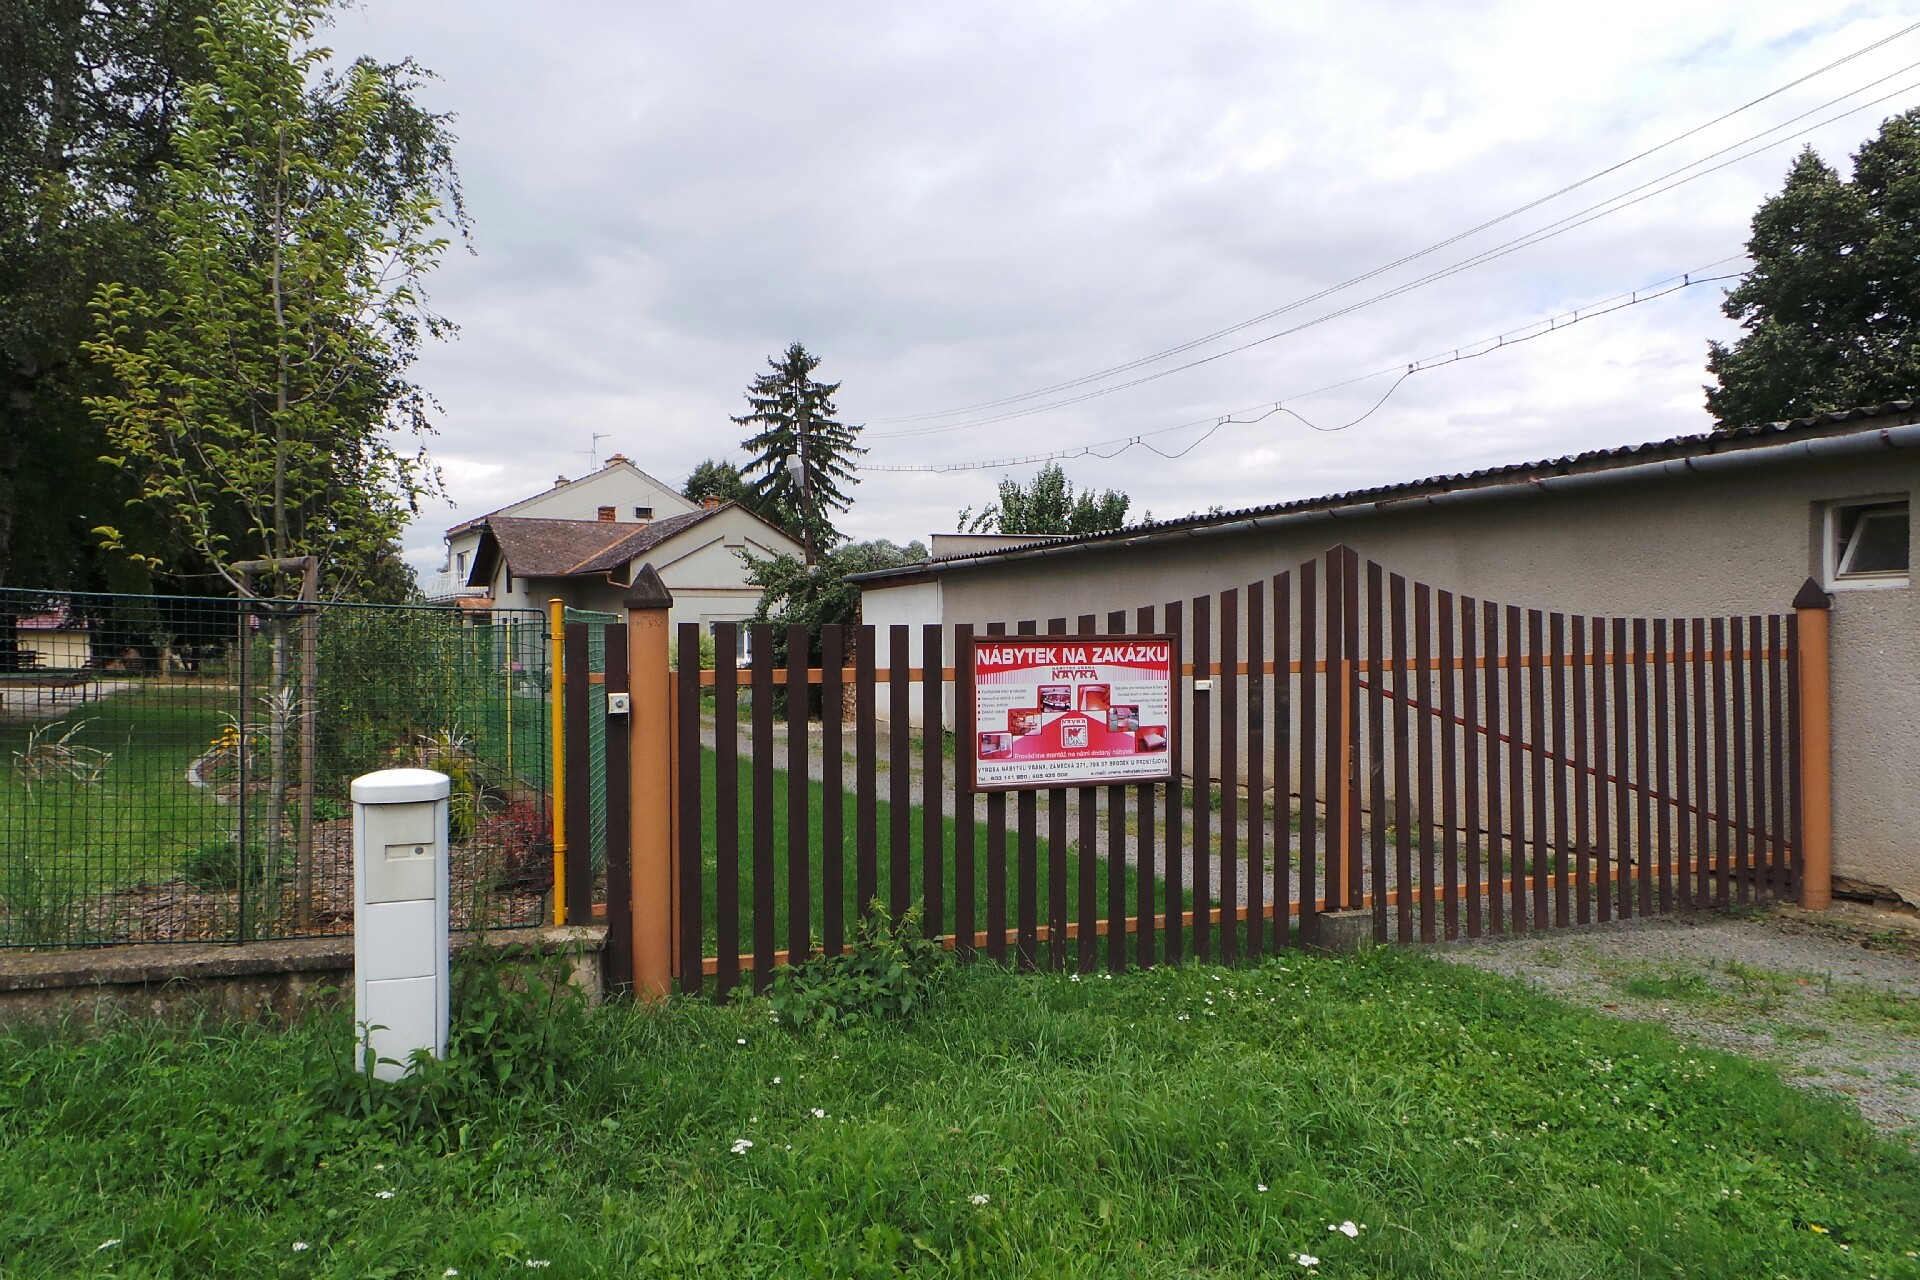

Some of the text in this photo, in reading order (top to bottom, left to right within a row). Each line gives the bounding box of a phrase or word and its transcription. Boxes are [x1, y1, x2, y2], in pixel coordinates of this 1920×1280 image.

[976, 642, 1168, 666] NÁBYTEK NA ZAKÁZKU
[1052, 670, 1098, 681] NAVRA
